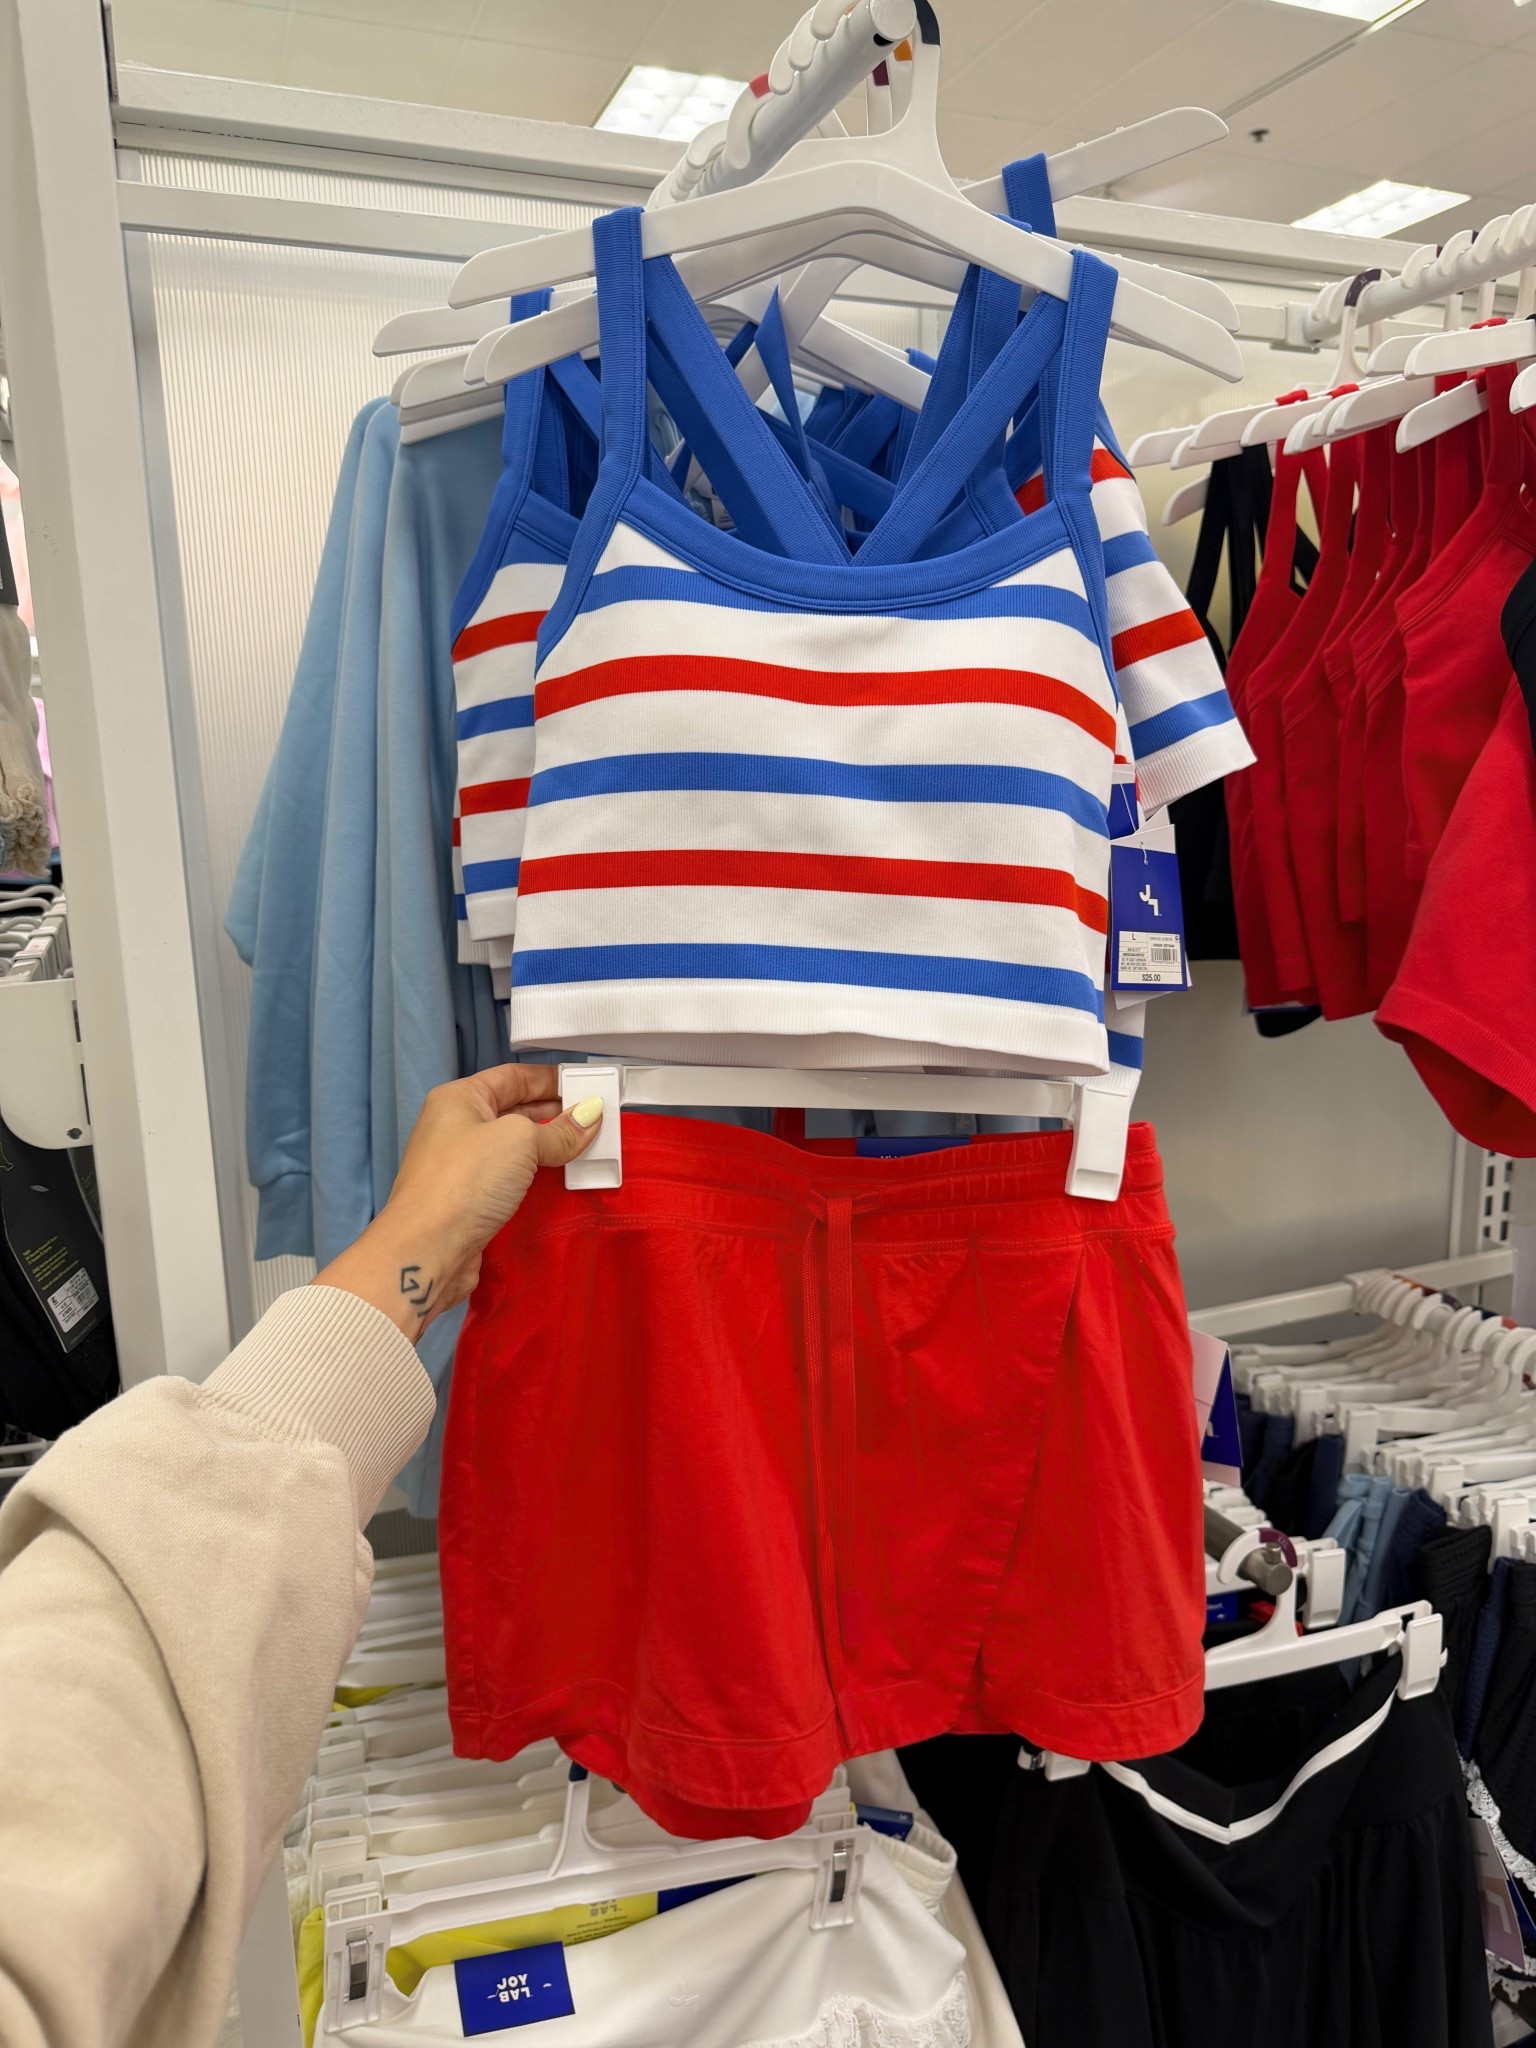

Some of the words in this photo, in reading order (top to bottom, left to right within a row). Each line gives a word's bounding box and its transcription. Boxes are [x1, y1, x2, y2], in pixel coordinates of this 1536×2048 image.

[1132, 933, 1136, 941] L
[1142, 974, 1161, 982] $25.00
[496, 1973, 528, 1990] JOY
[498, 1986, 531, 2003] LAB
